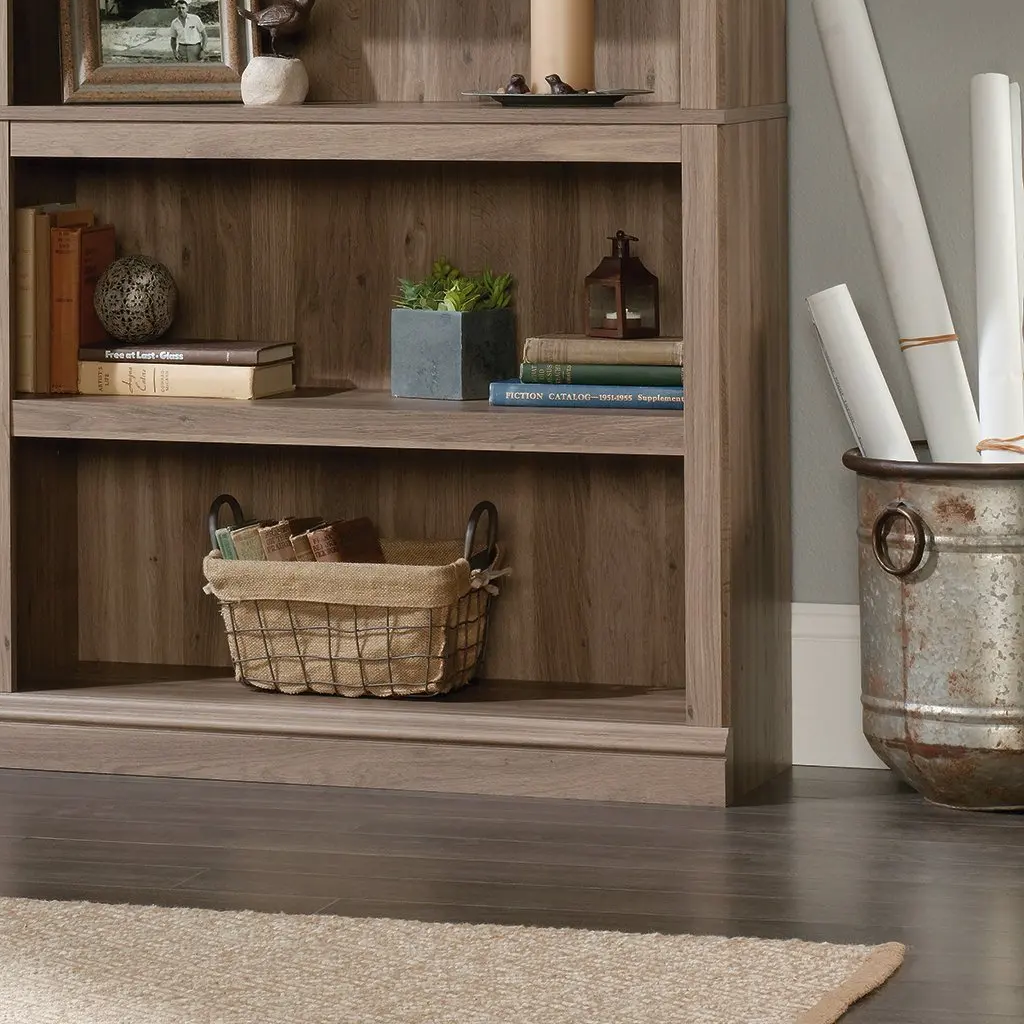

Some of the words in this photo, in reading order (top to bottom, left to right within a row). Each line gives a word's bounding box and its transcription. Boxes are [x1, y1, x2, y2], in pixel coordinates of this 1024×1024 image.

[104, 350, 124, 359] Free
[136, 351, 156, 360] Last
[160, 352, 184, 360] Glass
[504, 392, 544, 400] FICTION
